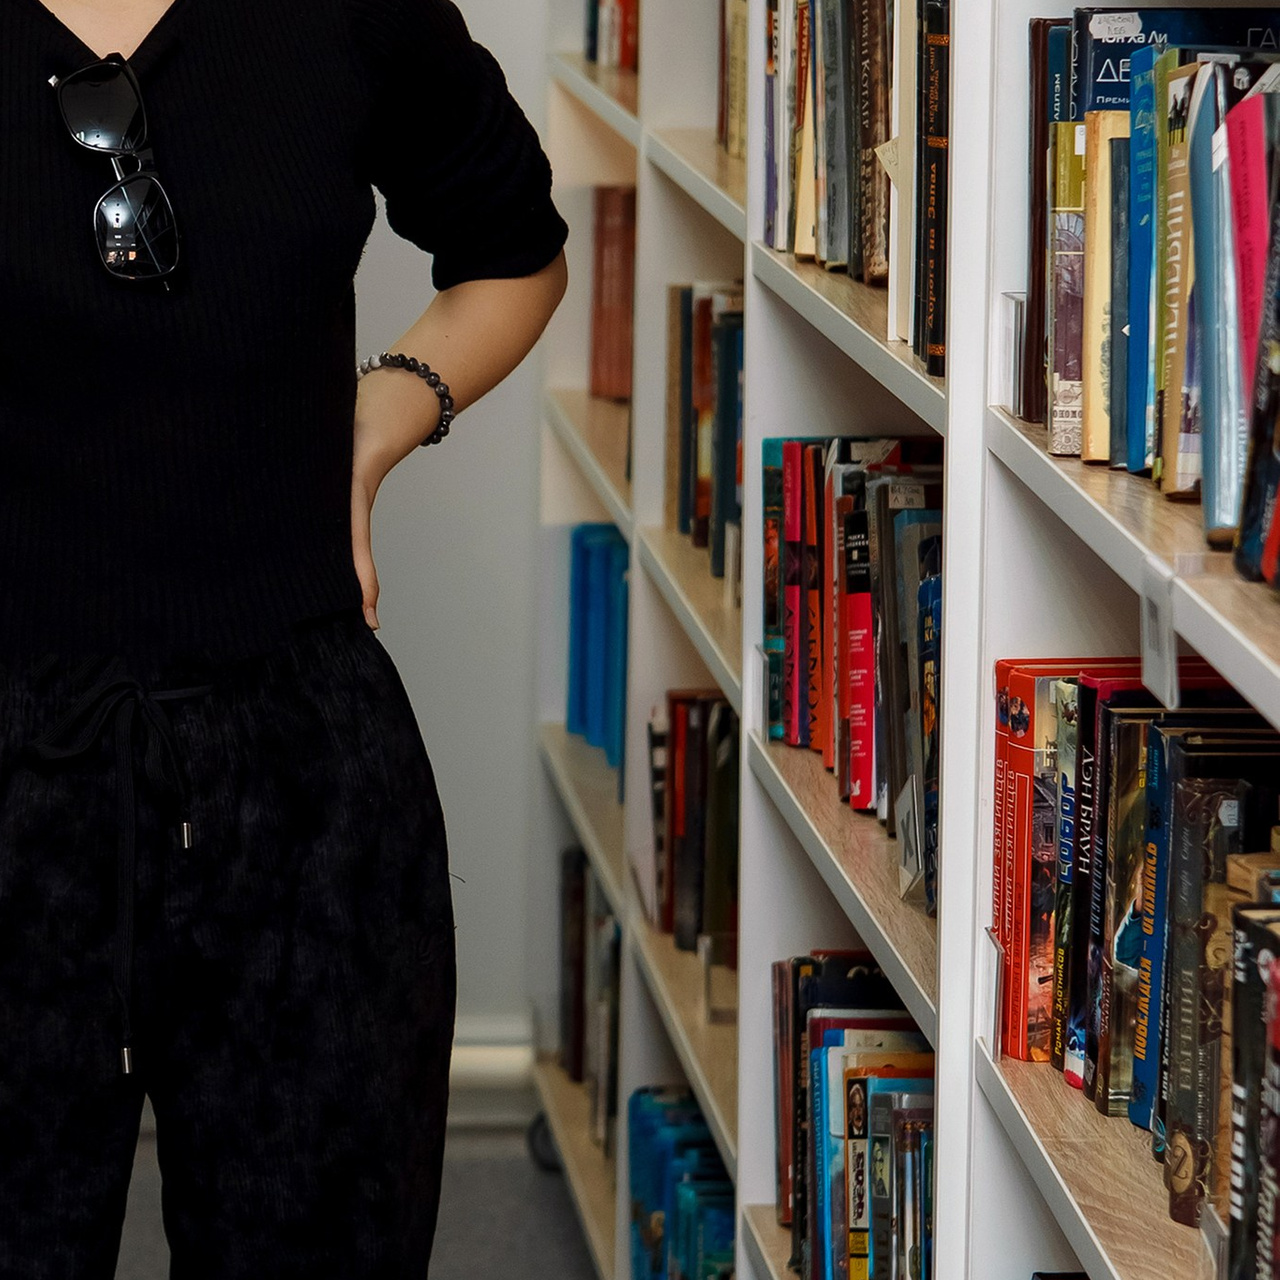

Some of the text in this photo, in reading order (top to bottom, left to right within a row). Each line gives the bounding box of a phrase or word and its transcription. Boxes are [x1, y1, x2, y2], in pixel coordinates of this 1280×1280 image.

[1126, 32, 1146, 44] Ха
[1147, 31, 1168, 44] Ли
[927, 162, 937, 328] Дорога на Запад
[994, 758, 1005, 858] ЗВЯГИНЦЕВ
[1005, 770, 1016, 868] ЗВЯГИНЦЕВ
[1078, 745, 1095, 876] ДЭН БРАУН
[812, 1061, 823, 1113] ШТУРМ
